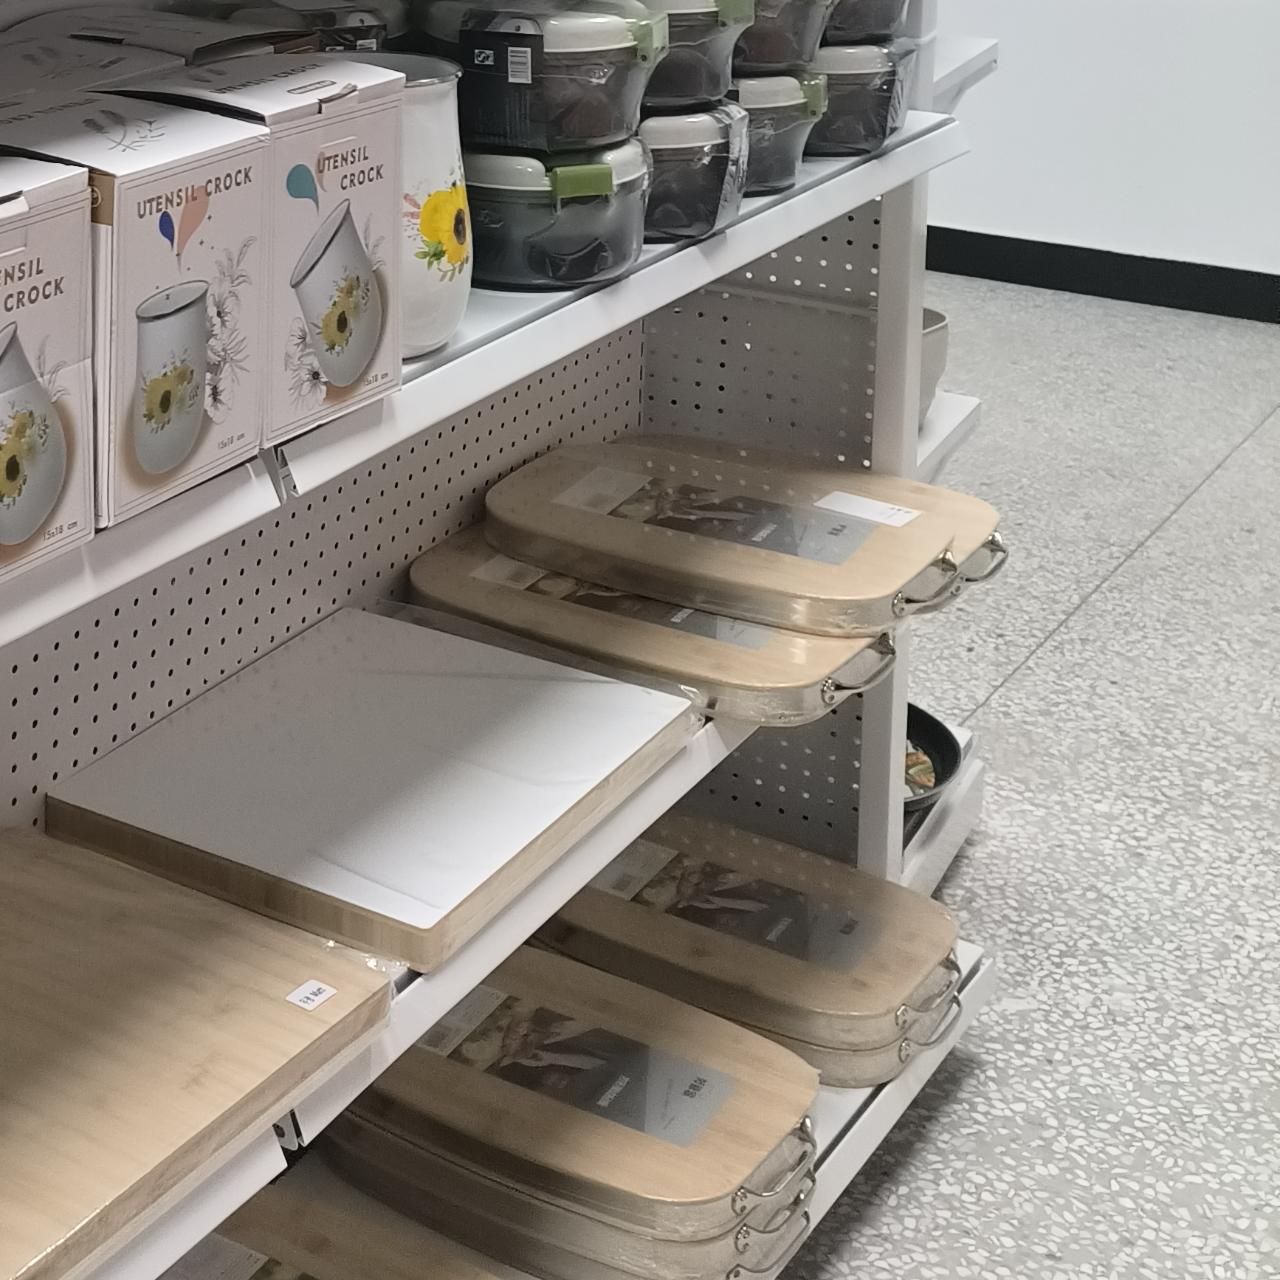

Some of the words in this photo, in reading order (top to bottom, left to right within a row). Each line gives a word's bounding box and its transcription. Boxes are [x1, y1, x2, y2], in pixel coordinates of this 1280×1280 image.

[315, 144, 370, 175] UTENSIL
[136, 181, 199, 219] UTENSIL
[204, 165, 253, 198] CROCK
[339, 164, 385, 192] CROCK
[3, 275, 66, 314] CROCK
